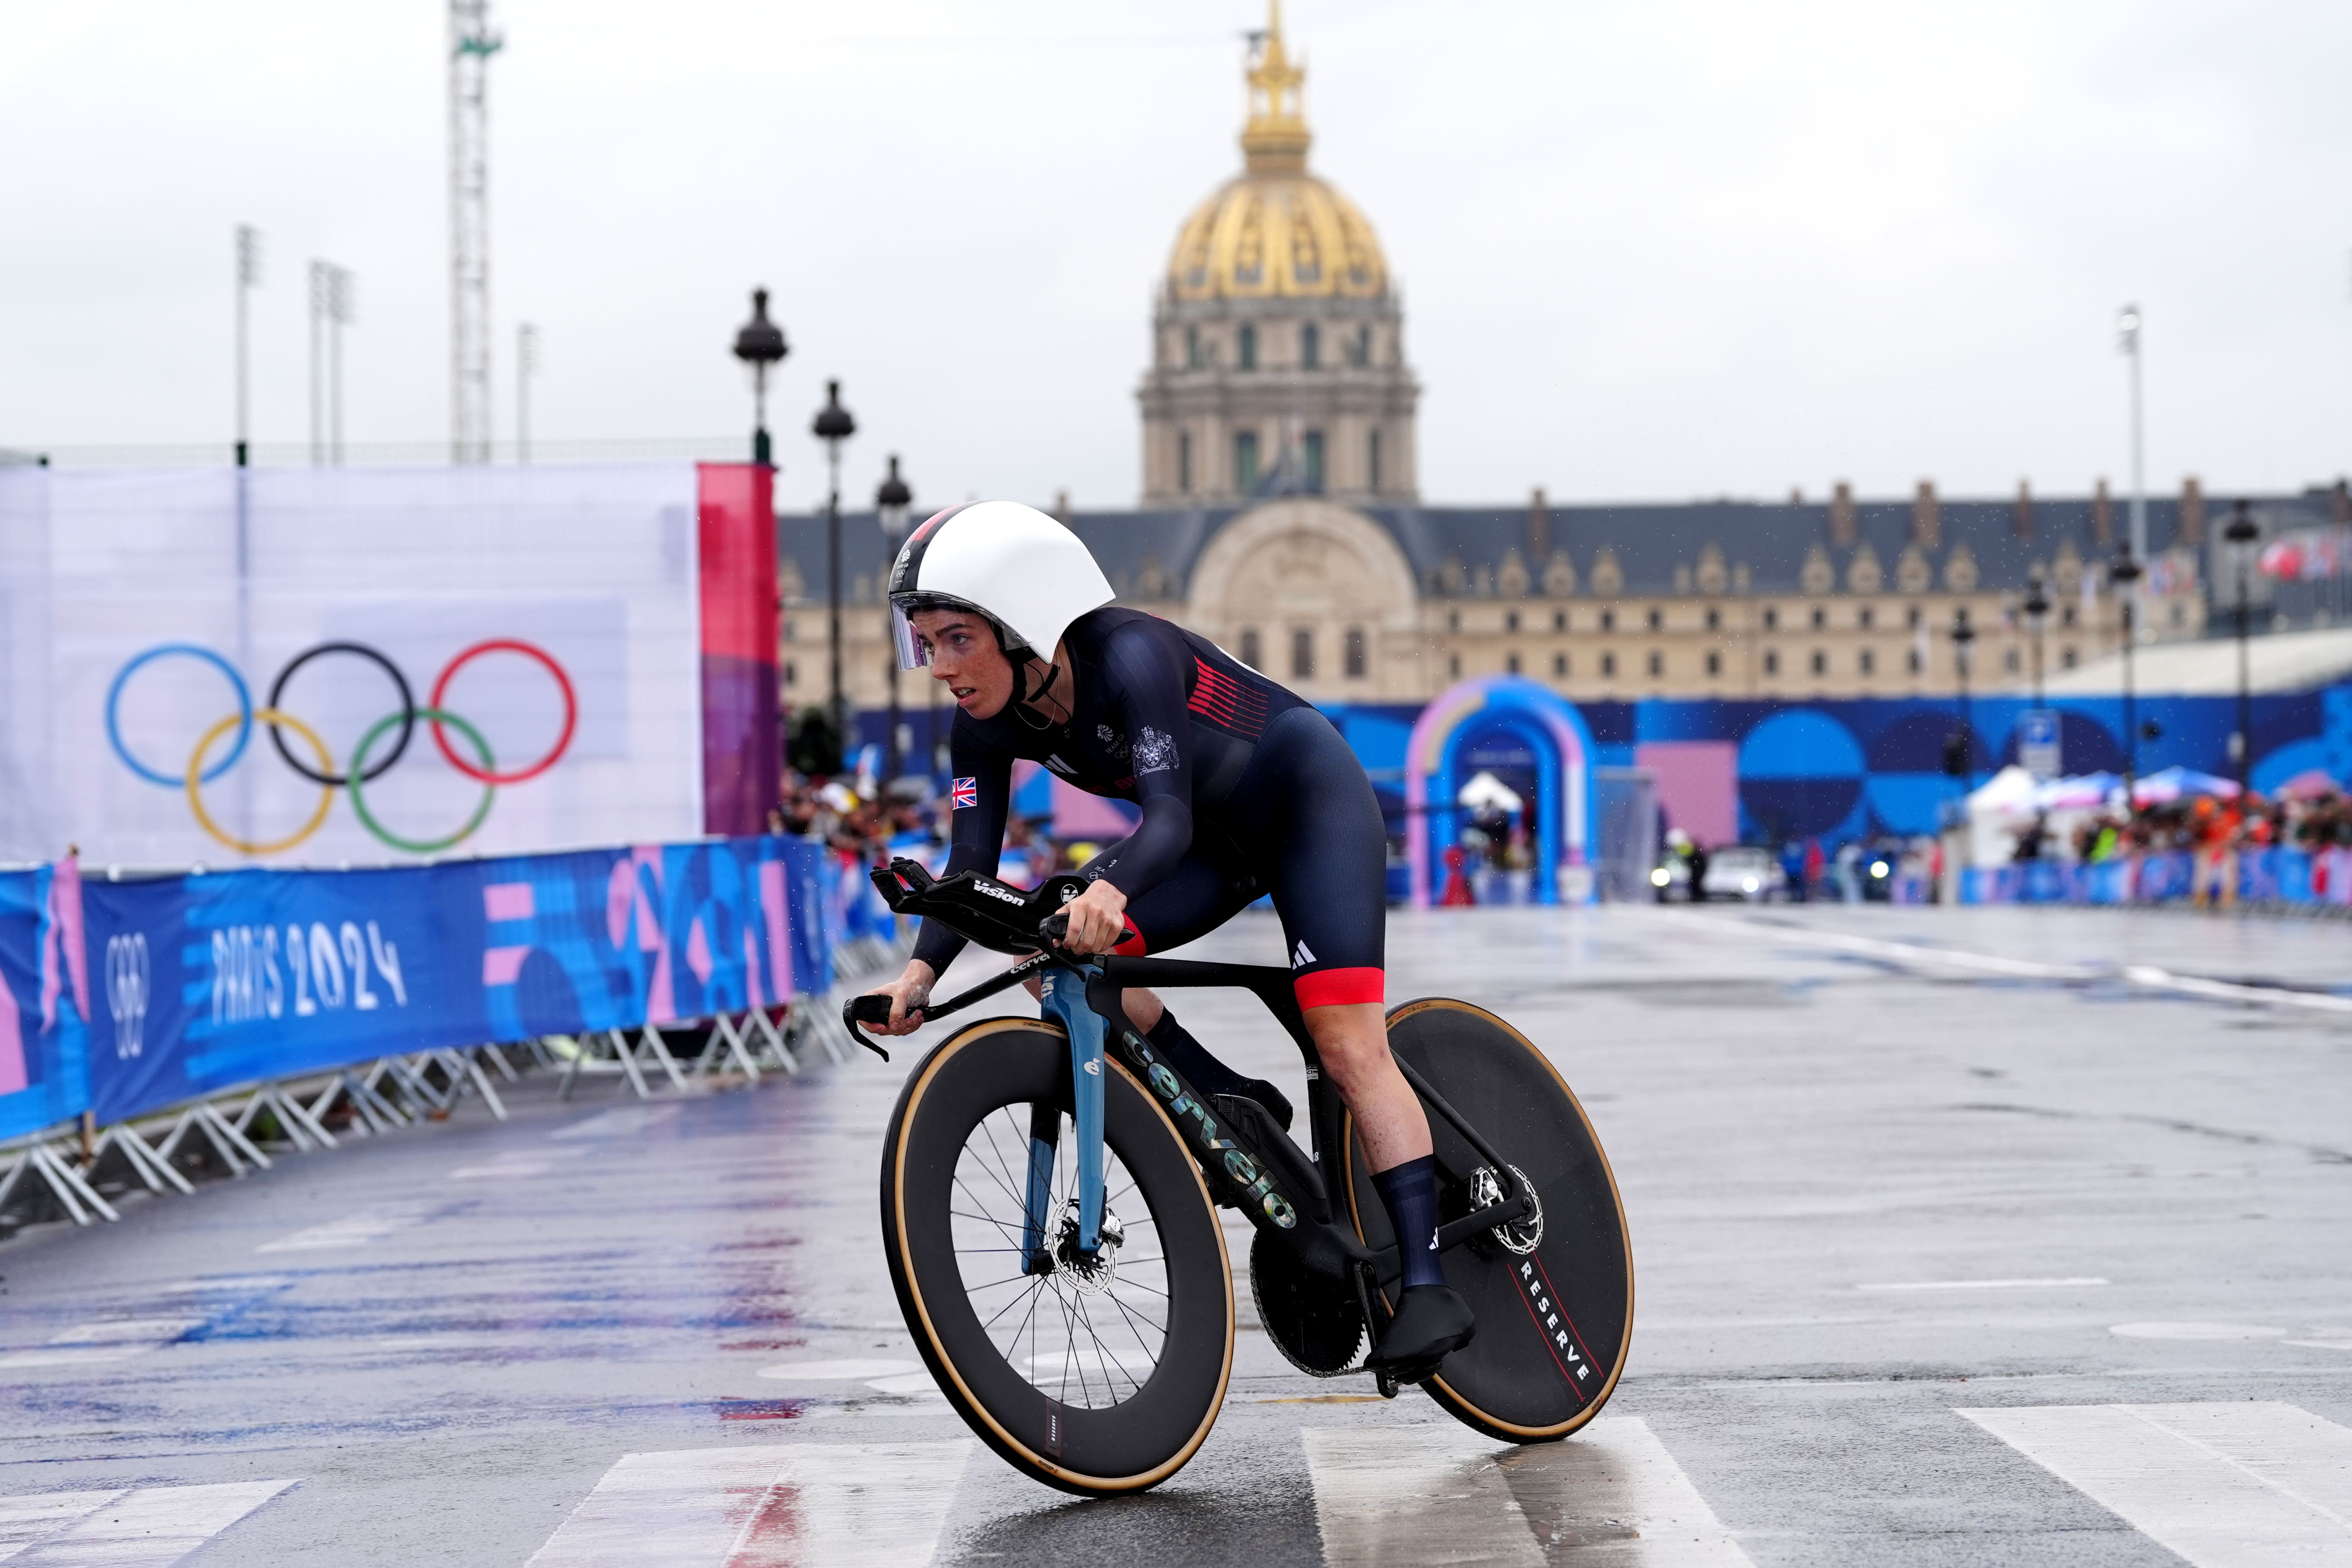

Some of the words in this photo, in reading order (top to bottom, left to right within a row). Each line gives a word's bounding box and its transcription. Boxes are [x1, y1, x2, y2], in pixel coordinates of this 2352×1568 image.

[1105, 741, 1120, 754] TEAM
[1118, 733, 1126, 743] GB
[286, 919, 409, 1017] 2024
[1122, 1030, 1297, 1229] cervélo
[1520, 1261, 1590, 1381] RESERVE
